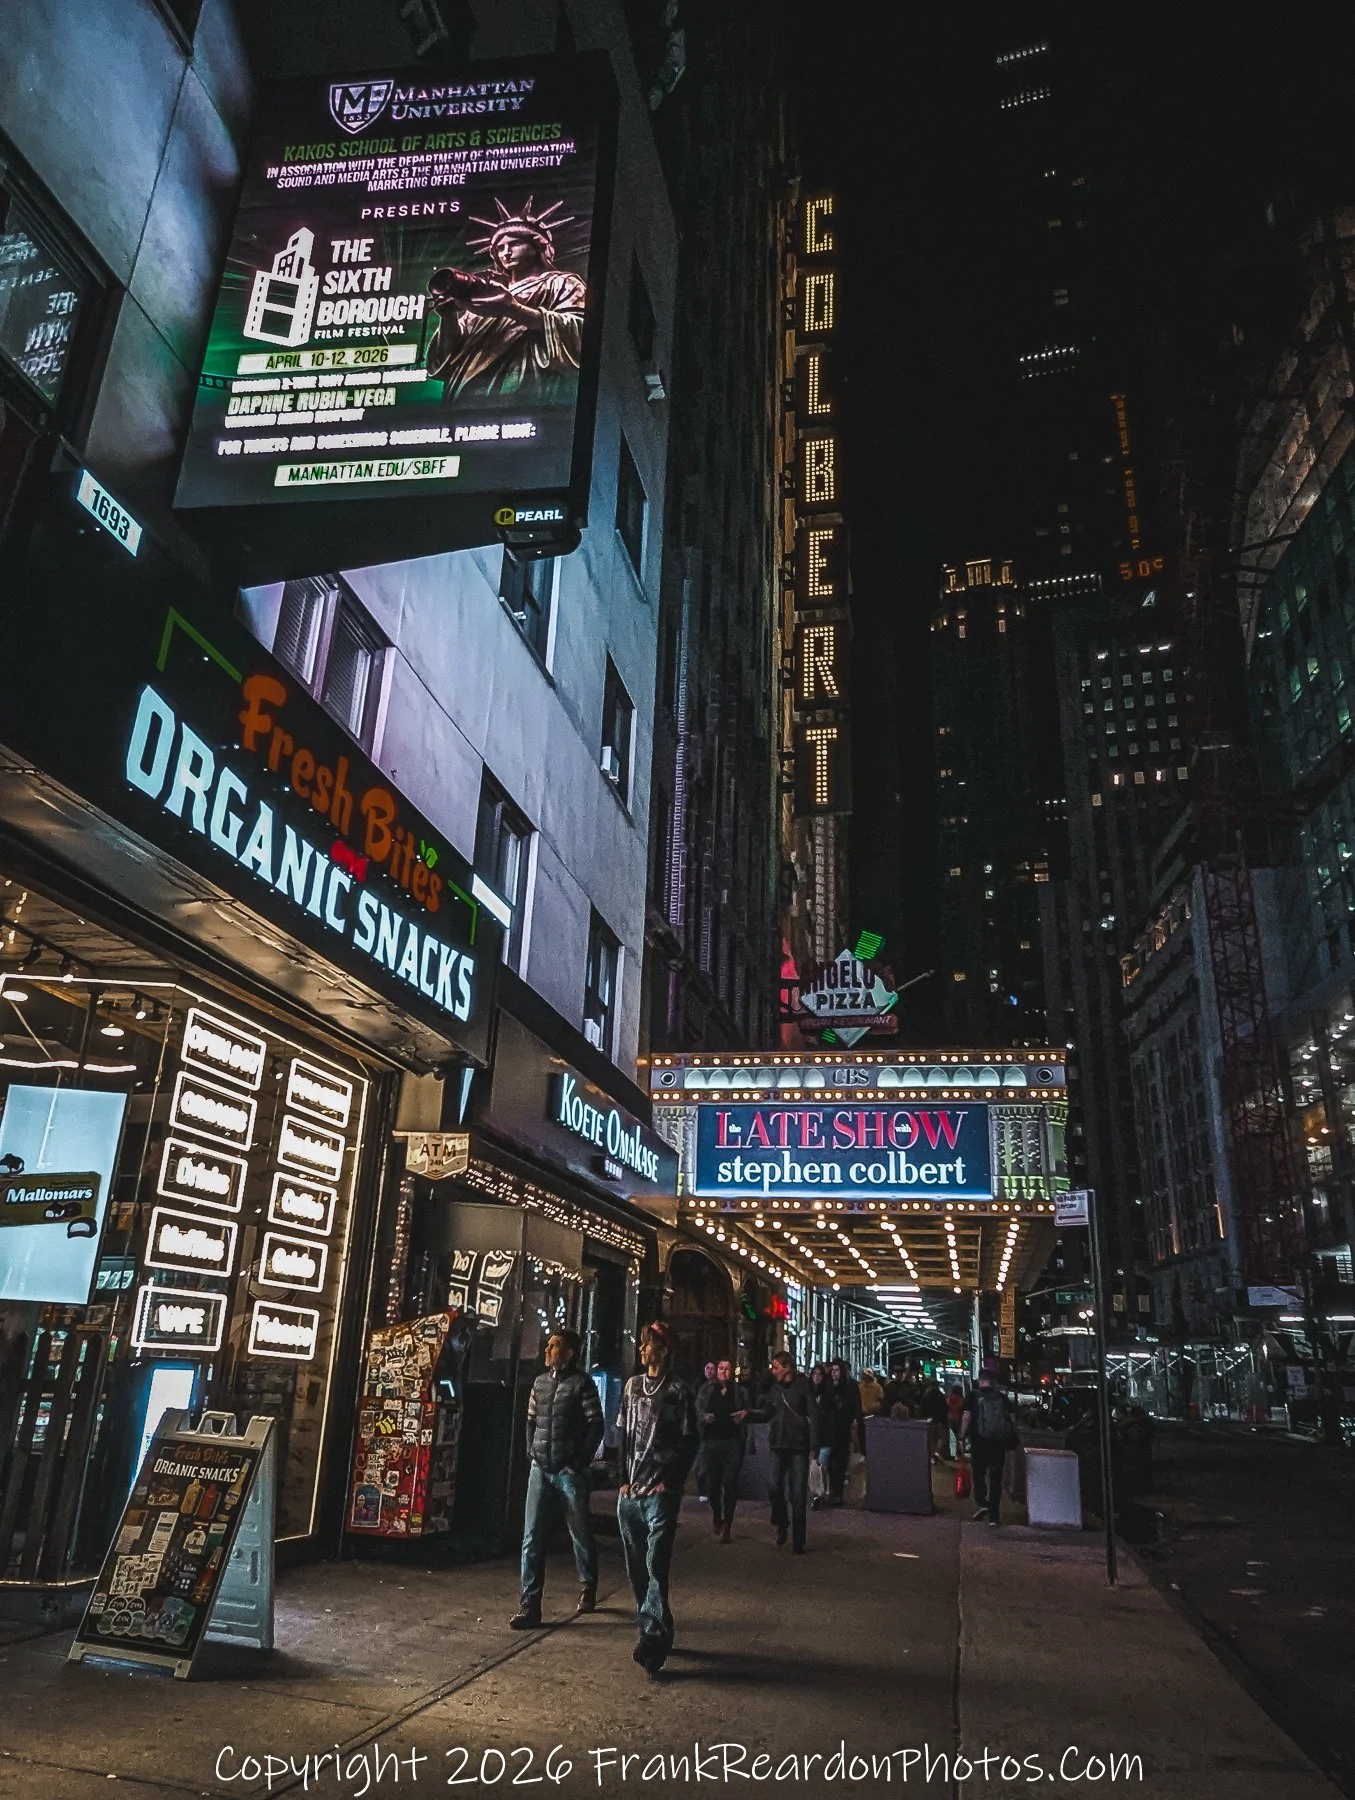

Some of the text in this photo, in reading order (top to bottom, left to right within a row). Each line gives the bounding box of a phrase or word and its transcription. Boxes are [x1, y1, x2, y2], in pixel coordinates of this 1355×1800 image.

[393, 80, 535, 103] MANHATTAN
[391, 98, 525, 120] UNIVERSITY
[284, 123, 562, 162] KAKOS SCHOOL OF ARTS & SCIENCES
[267, 167, 278, 178] IN
[280, 161, 347, 177] ASSOCIATION
[349, 159, 375, 171] WITH
[377, 157, 397, 168] THE
[398, 151, 468, 167] DEPARTMENT
[470, 150, 483, 161] OF
[277, 155, 564, 189] SOUND AND MEDIA ARTS & THE MANHATTAN UNIVERSITY
[367, 174, 466, 192] MARKETING OFFICE
[361, 201, 460, 219] PRESENTS
[330, 238, 375, 263] THE
[322, 267, 392, 295] SIXTH
[316, 294, 426, 327] BOROUGH
[314, 324, 405, 340] FILM FESTIVAL
[266, 354, 302, 370] APRIL
[354, 348, 389, 364] 2026
[227, 387, 397, 415] DAPHNE RUBIN-VEGA
[288, 459, 448, 482] MANHATTAN.EDU/SBFF
[804, 197, 840, 804] COLBERT
[91, 487, 131, 542] 1693
[515, 509, 564, 522] PEARL
[238, 674, 444, 913] Fresh Bites
[126, 685, 475, 1022] ORGANIC SNACKS
[815, 991, 877, 1011] PIZZA
[832, 1068, 870, 1086] CBS
[715, 1111, 968, 1150] LATE SHOW
[894, 1123, 912, 1134] with
[419, 1143, 457, 1158] ATM
[717, 1151, 967, 1193] stephen colbert
[6, 1188, 93, 1203] Mallomars
[153, 1458, 240, 1483] ORGANIC SNACKS
